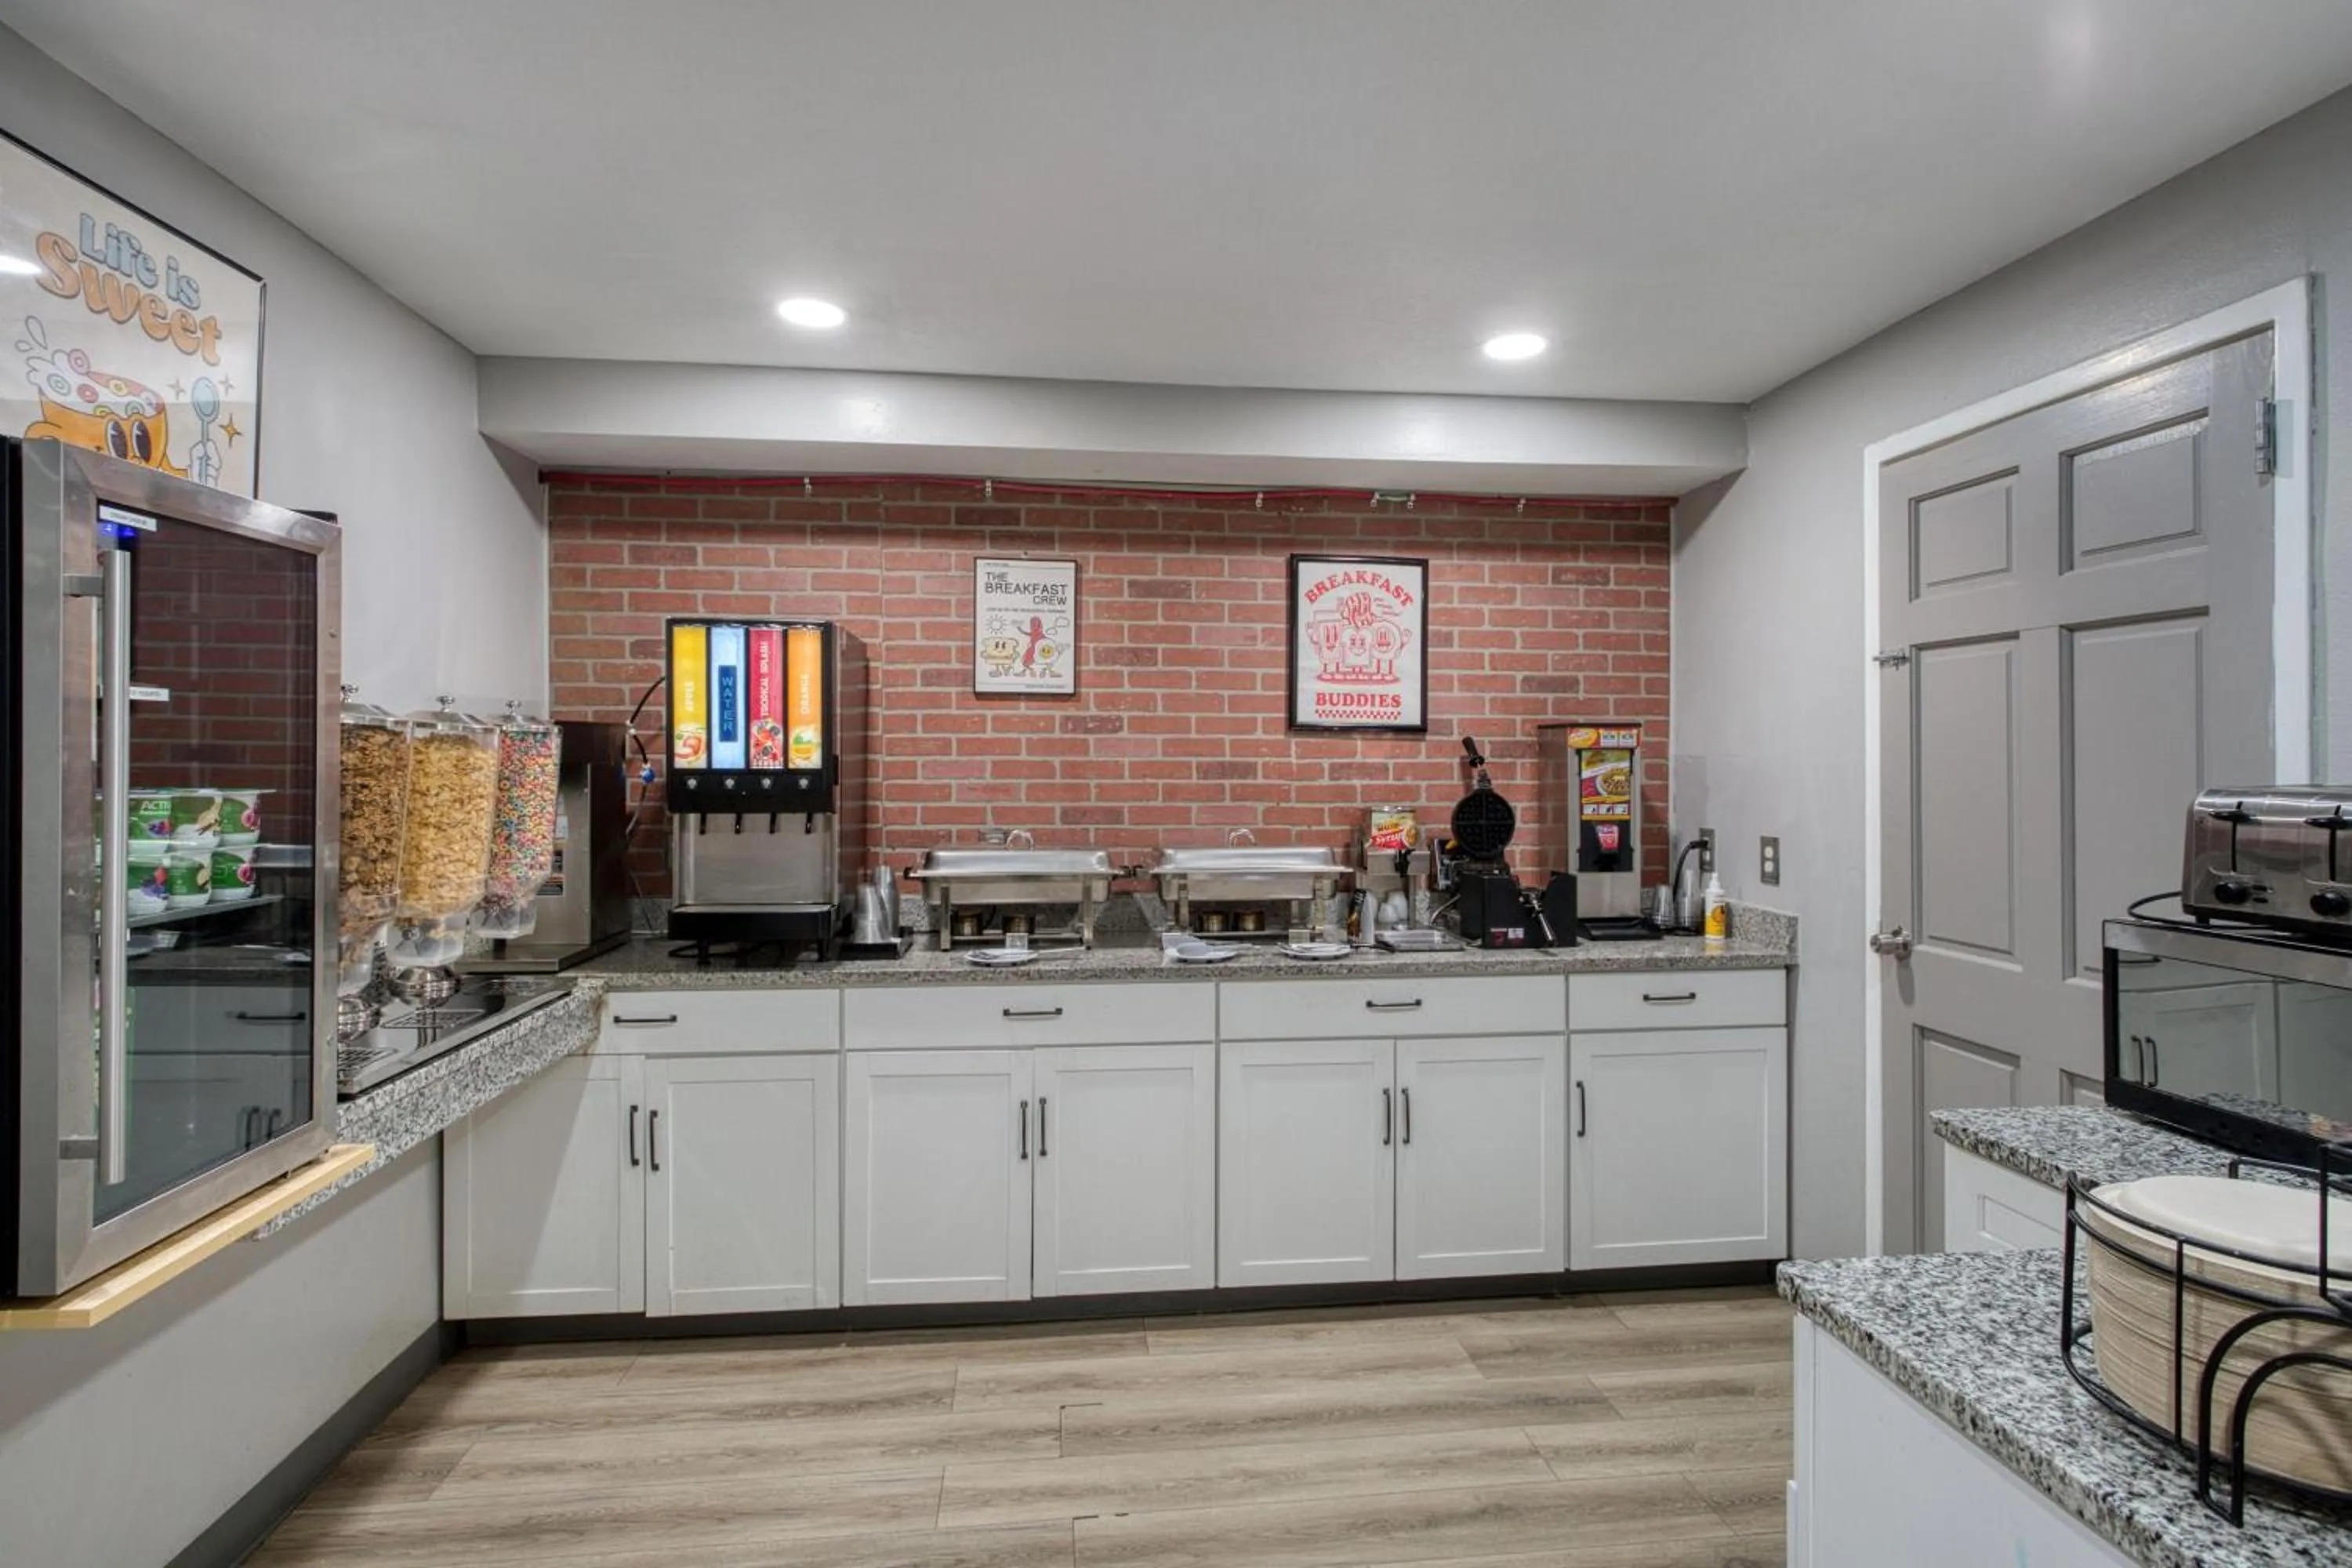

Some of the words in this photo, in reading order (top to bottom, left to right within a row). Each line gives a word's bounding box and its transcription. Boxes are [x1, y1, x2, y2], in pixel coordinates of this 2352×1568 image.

[79, 212, 159, 289] Life
[165, 255, 201, 310] is
[34, 231, 222, 366] Sweet
[985, 572, 1008, 582] THE
[985, 583, 1068, 596] BREAKFAST
[1304, 570, 1414, 609] BREAKFAST
[1033, 596, 1067, 606] CREW
[722, 677, 735, 731] WATER
[1316, 692, 1402, 708] BUDDIES
[140, 800, 171, 811] ACTI
